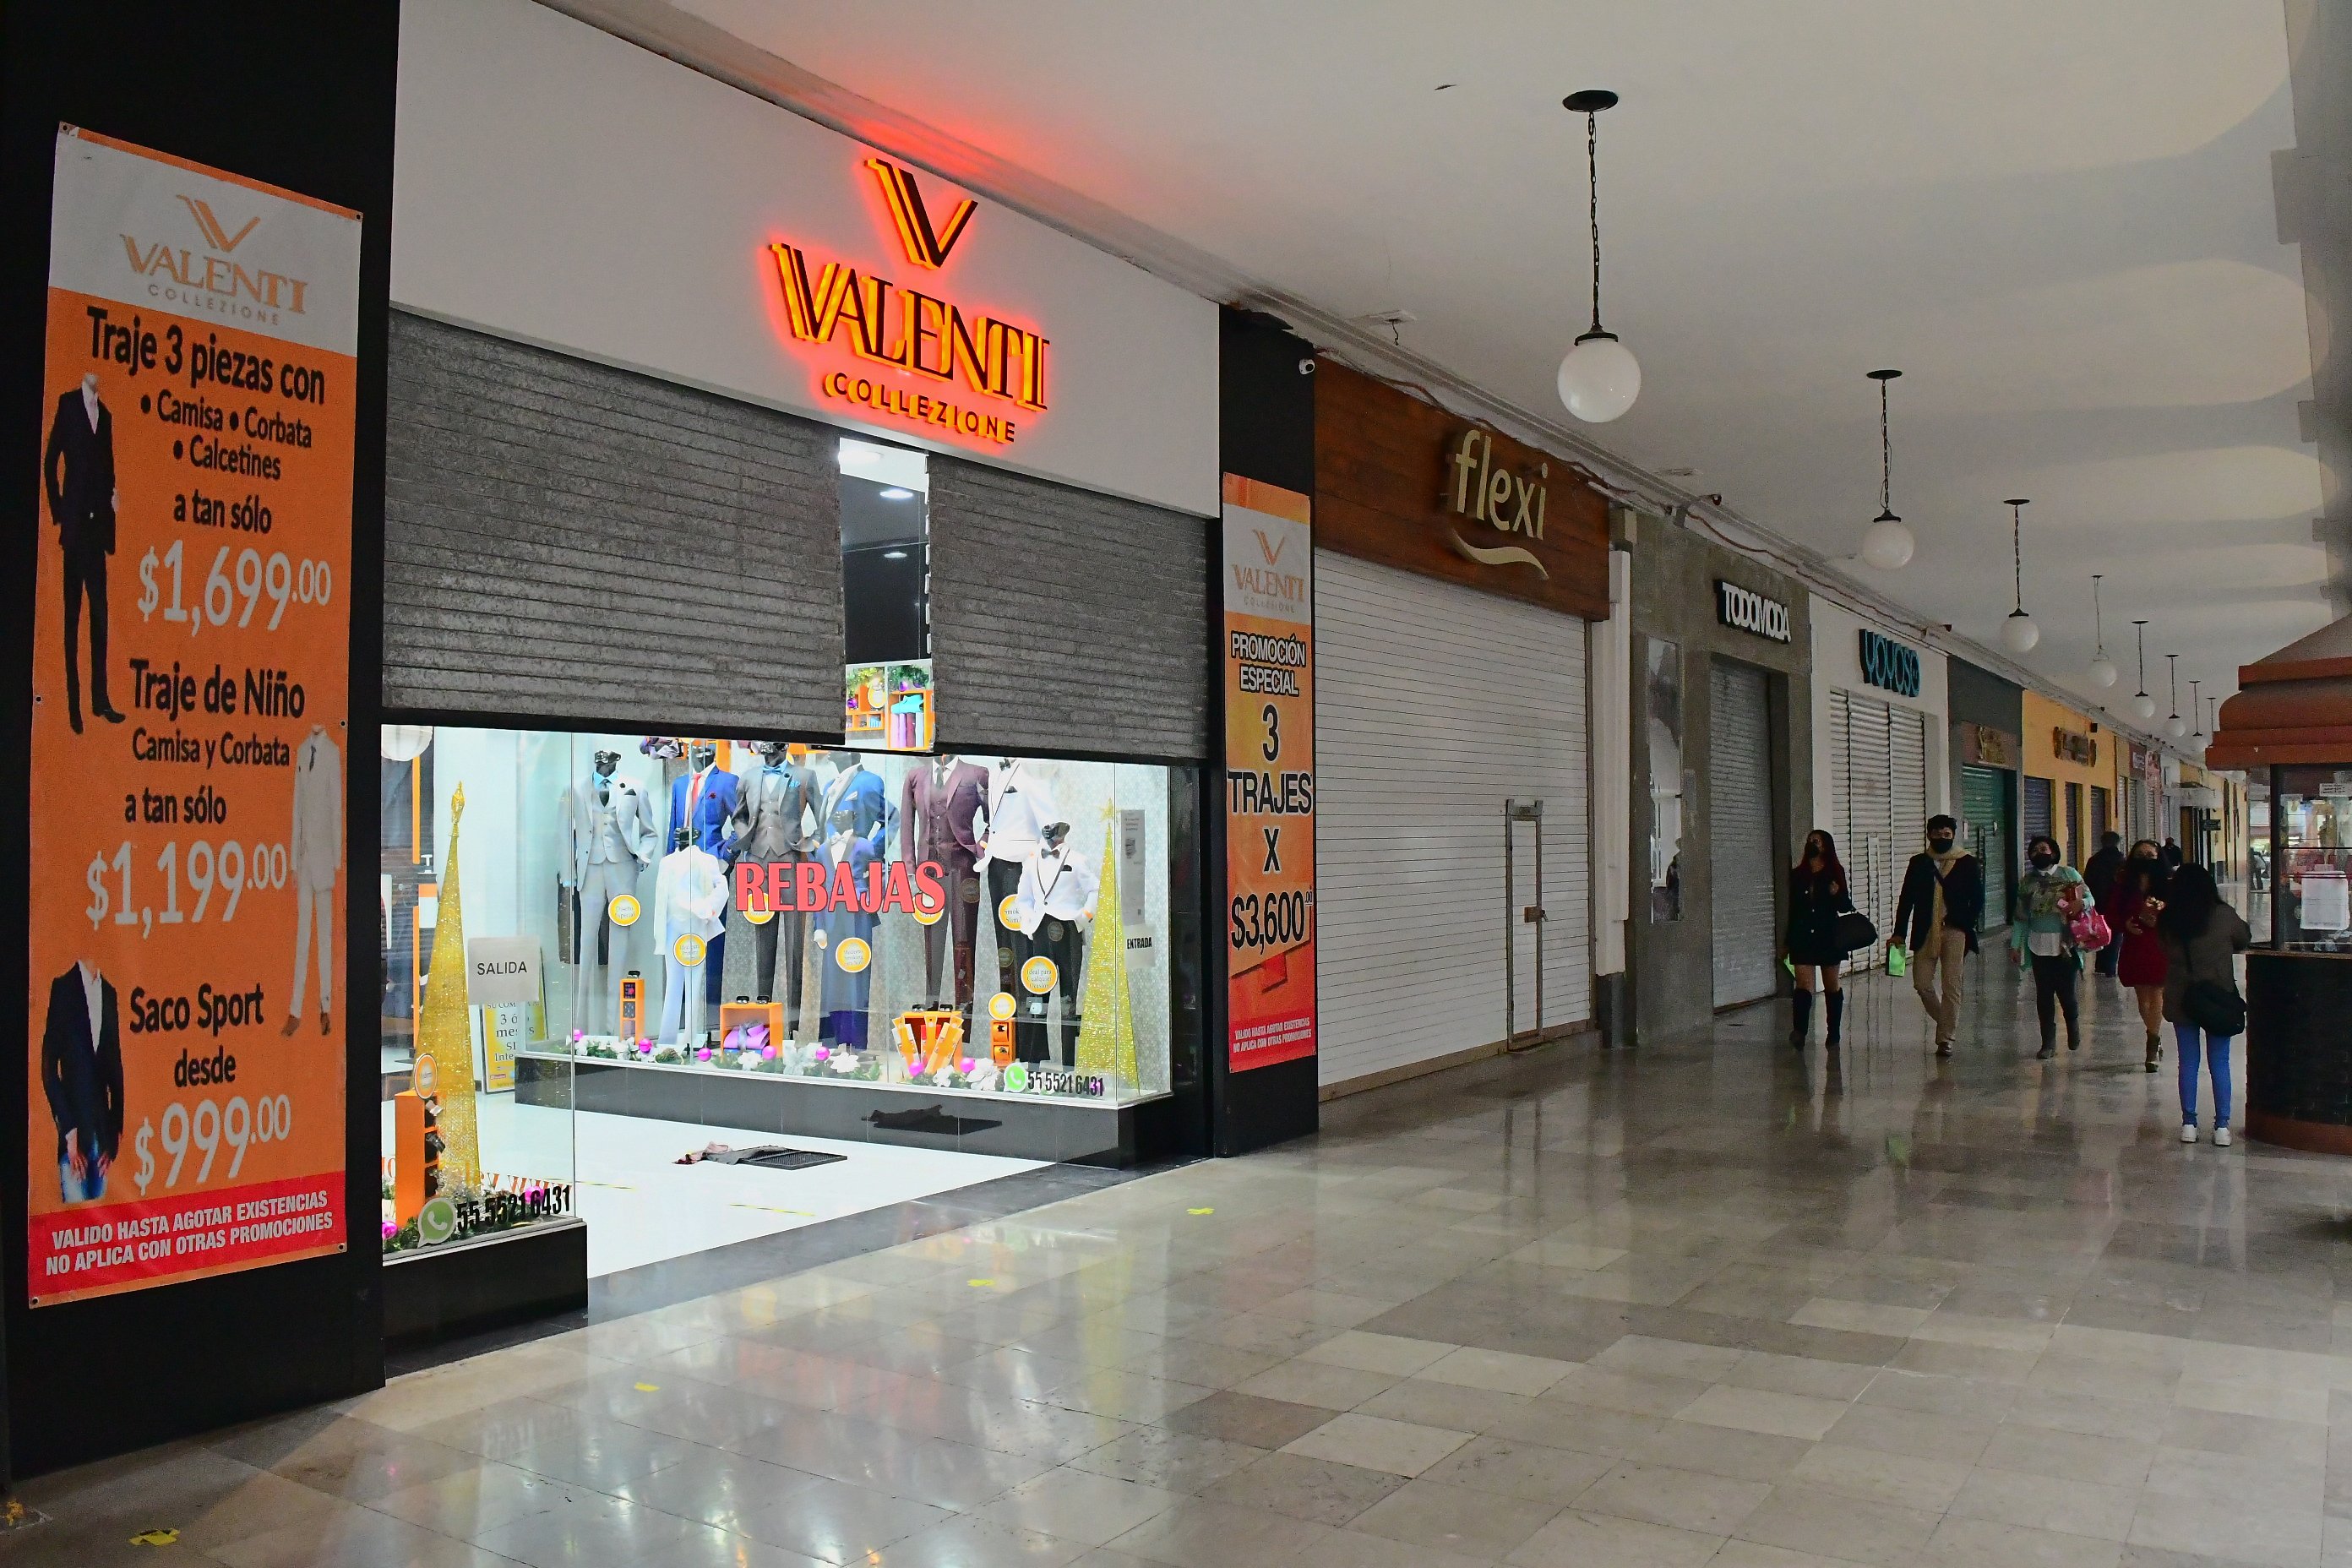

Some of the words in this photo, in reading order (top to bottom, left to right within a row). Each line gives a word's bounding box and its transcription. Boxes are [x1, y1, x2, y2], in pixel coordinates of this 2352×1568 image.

[119, 233, 308, 315] VALENTI
[148, 283, 280, 326] COLLEZIONE
[769, 242, 1050, 412] VALENTI
[87, 306, 157, 376] Traje
[166, 324, 182, 374] 3
[191, 333, 274, 391] piezas
[280, 362, 325, 405] con
[157, 389, 224, 432] Camisa
[244, 406, 313, 449] Corbata
[823, 372, 1015, 444] COLLEZIONE
[189, 434, 281, 480] Calcetines
[173, 493, 186, 522] a
[192, 489, 226, 528] tan
[231, 494, 272, 534] sólo
[1455, 429, 1549, 541] flexi
[137, 539, 332, 637] $1,699.00
[1232, 564, 1304, 602] VALENTI
[1722, 581, 1792, 643] TODOMODA
[1231, 630, 1307, 667] PROMOCIÓN
[129, 657, 196, 721] Traje
[203, 663, 237, 714] de
[243, 668, 305, 719] Niño
[1239, 662, 1299, 697] ESPECIAL
[132, 727, 200, 762] Camisa
[205, 739, 216, 770] y
[220, 731, 290, 767] Corbata
[1261, 703, 1280, 762] 3
[124, 793, 137, 823] a
[142, 787, 177, 824] tan
[183, 785, 227, 825] sólo
[1228, 770, 1312, 814] TRAJES
[1263, 827, 1281, 873] X
[85, 840, 287, 940] $1,199.00
[735, 860, 946, 914] REBAJAS
[476, 961, 528, 976] SALIDA
[1126, 937, 1152, 950] ENTRADA
[129, 985, 190, 1034] Saco
[197, 982, 264, 1037] Sport
[500, 1014, 507, 1025] 3
[174, 1045, 237, 1088] desde
[1045, 1072, 1073, 1094] 5521
[1075, 1075, 1103, 1097] 6431
[133, 1094, 291, 1196] $999.00
[46, 1254, 71, 1277] NO
[74, 1244, 135, 1271] APLICA
[138, 1237, 172, 1261] CON
[176, 1230, 226, 1255] OTRAS
[230, 1211, 333, 1244] PROMOCIONES
[52, 1221, 113, 1250] VALIDO
[117, 1215, 170, 1241] HASTA
[173, 1206, 232, 1232] AGOTAR
[237, 1190, 328, 1222] EXISTENCIAS
